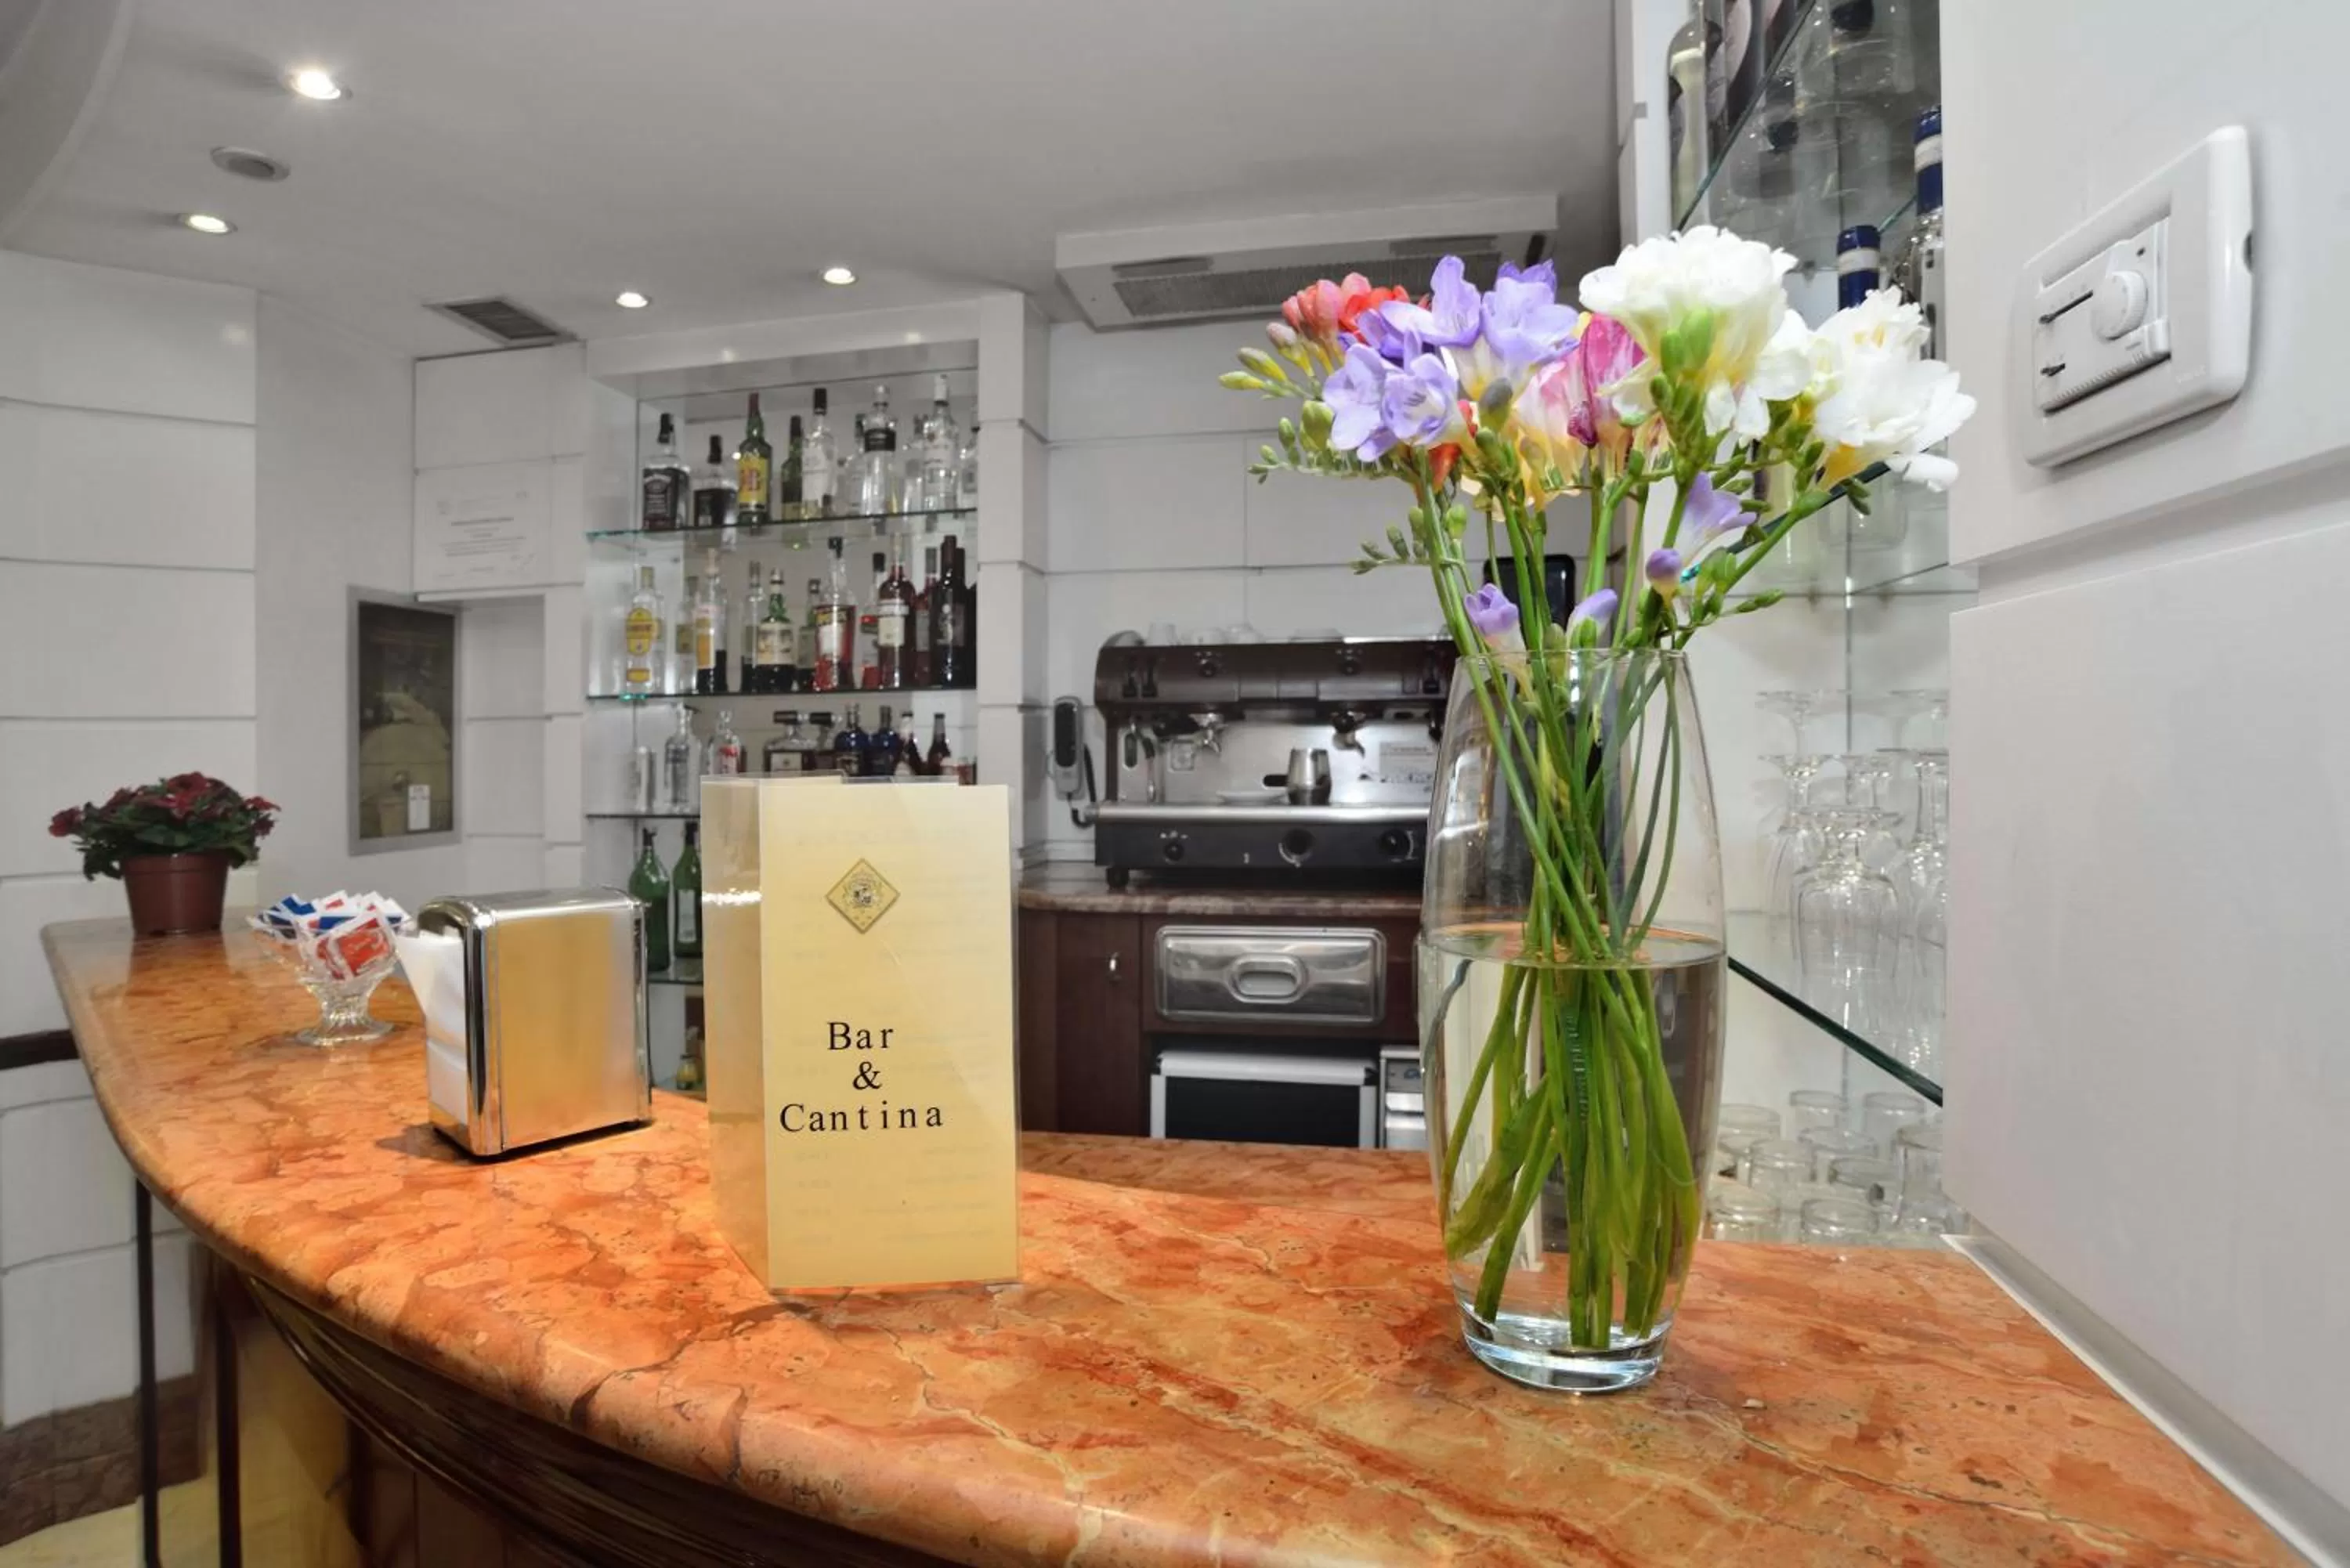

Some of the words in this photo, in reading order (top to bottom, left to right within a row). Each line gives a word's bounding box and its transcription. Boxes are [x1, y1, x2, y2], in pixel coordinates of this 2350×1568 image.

[827, 1021, 894, 1050] Bar
[852, 1060, 882, 1090] &
[779, 1100, 943, 1133] Cantina
